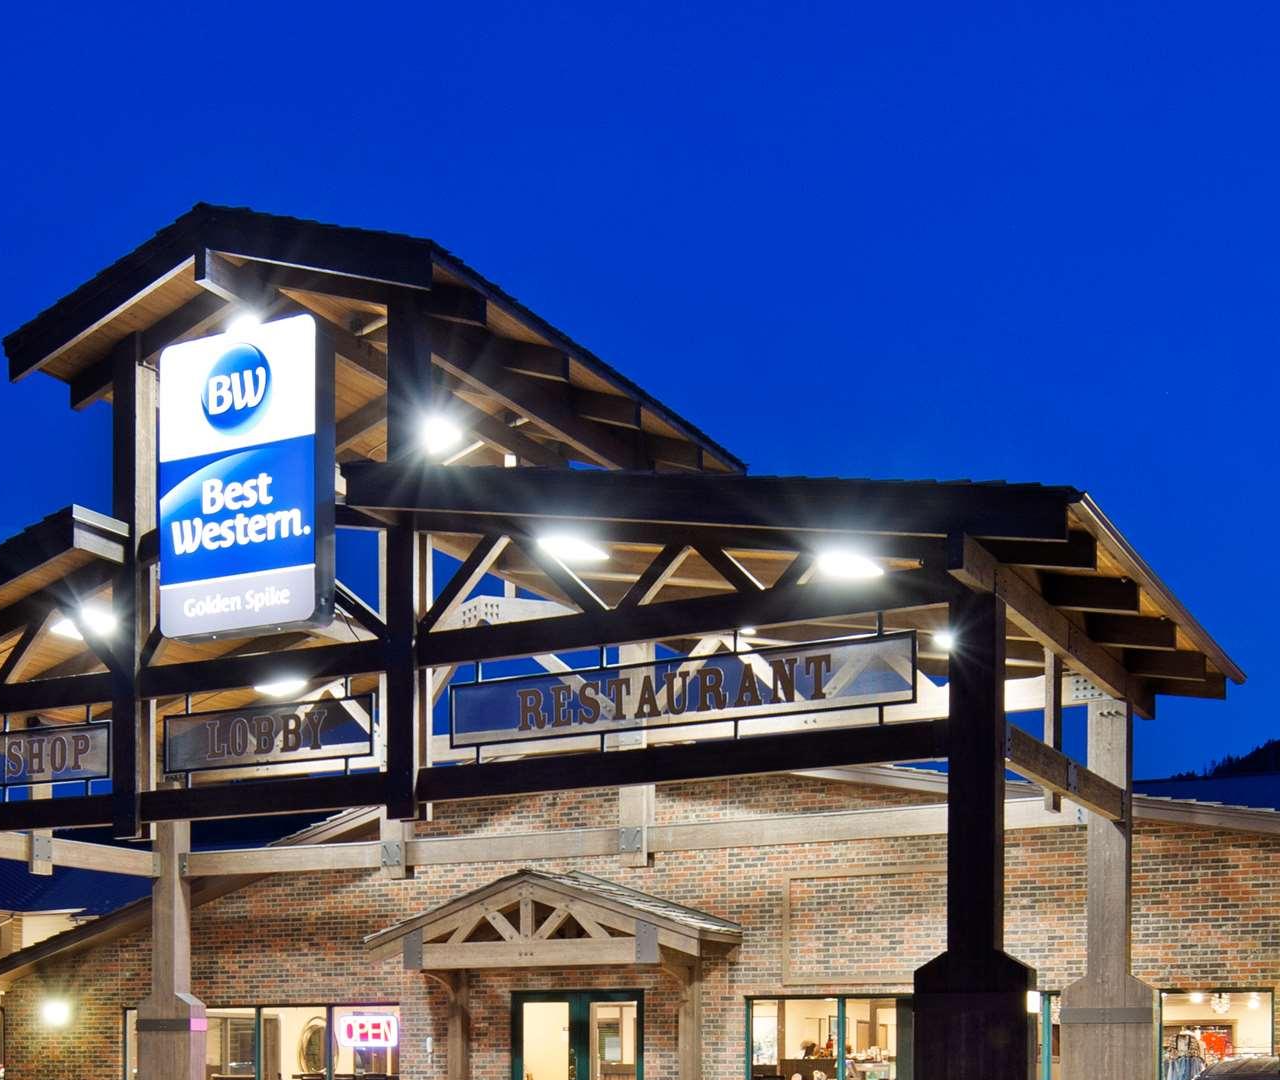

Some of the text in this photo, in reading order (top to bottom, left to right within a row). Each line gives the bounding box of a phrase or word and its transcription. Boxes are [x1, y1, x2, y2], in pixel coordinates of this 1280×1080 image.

[208, 367, 266, 415] BW
[202, 473, 273, 514] Best
[183, 585, 291, 618] Golden Spike
[518, 655, 831, 731] RESTAURANT
[5, 732, 91, 778] SHOP
[206, 708, 329, 760] LOBBY
[344, 1018, 395, 1043] OPEN
